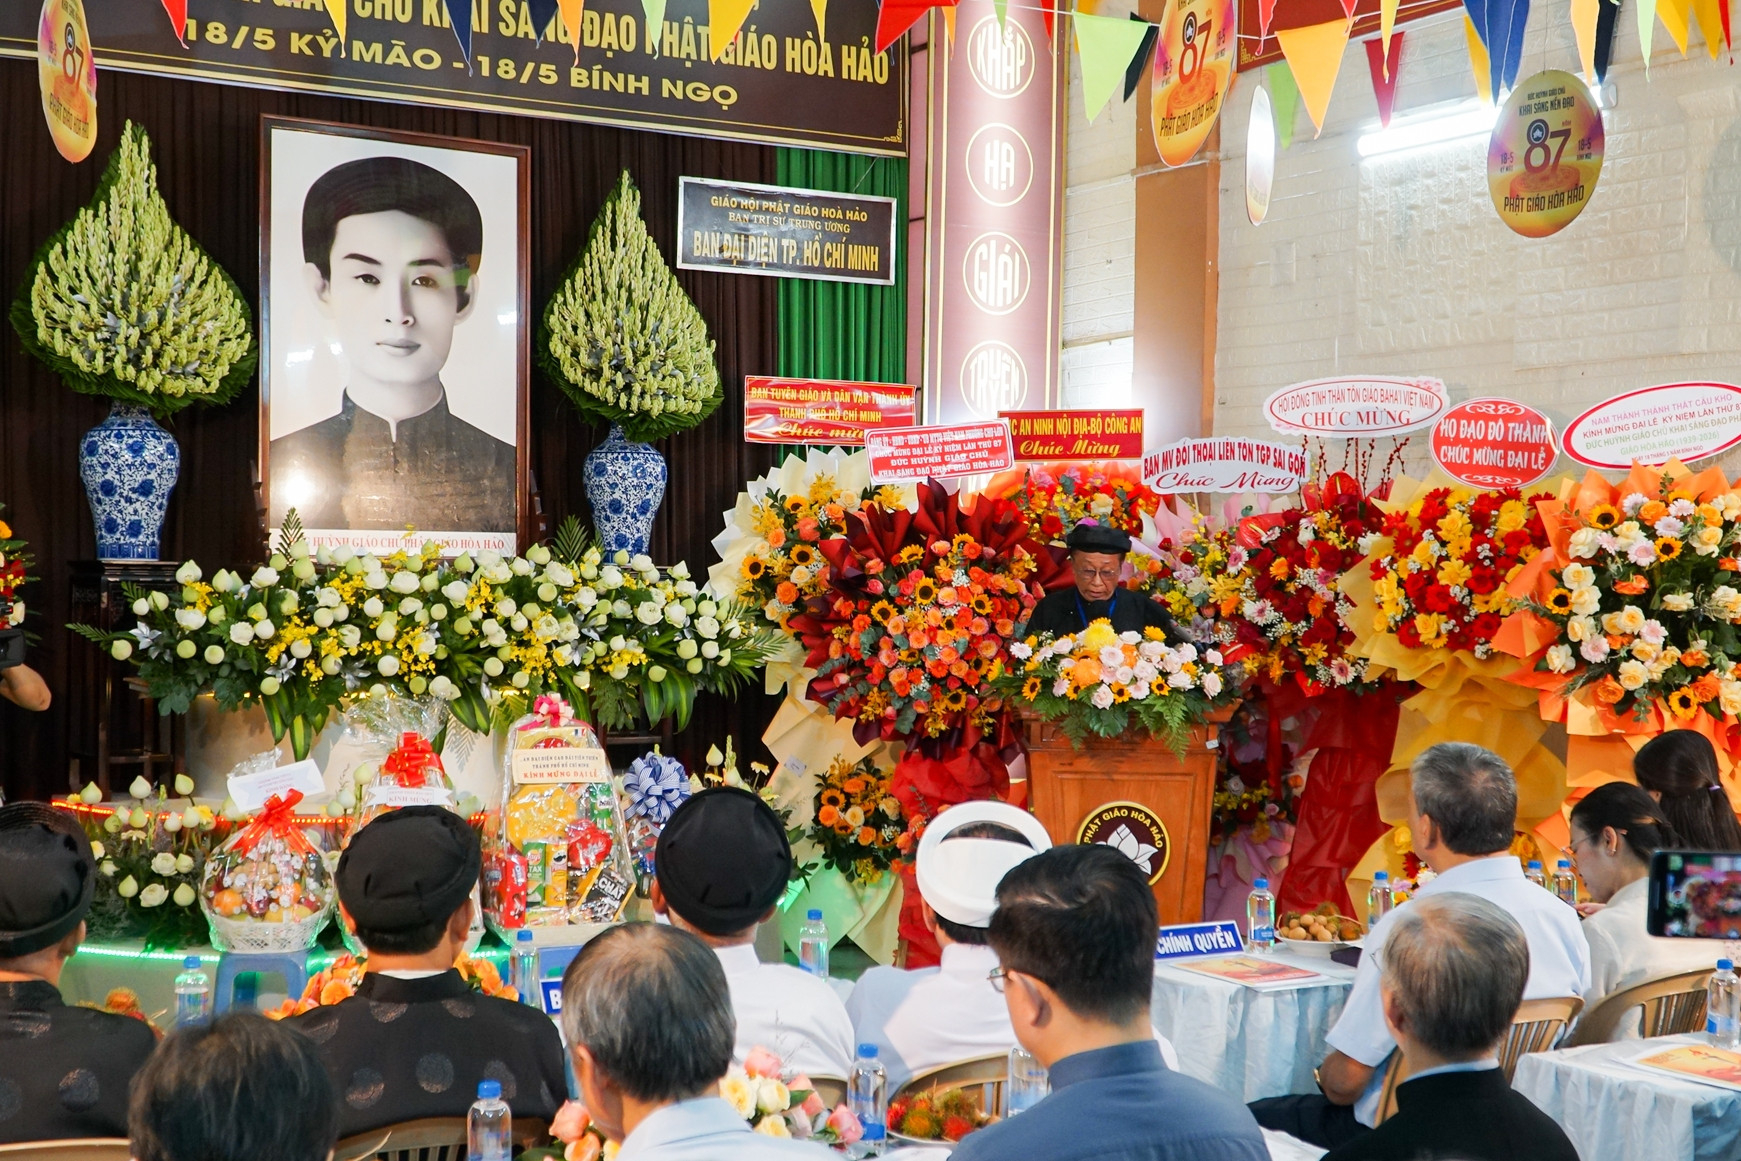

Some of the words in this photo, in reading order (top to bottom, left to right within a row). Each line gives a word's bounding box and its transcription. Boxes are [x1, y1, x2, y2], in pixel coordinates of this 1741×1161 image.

[582, 9, 637, 58] ĐẠO
[785, 30, 834, 78] HÒA
[841, 35, 889, 85] HẢO
[185, 18, 276, 51] 18/5
[290, 28, 339, 58] KỶ
[352, 39, 442, 70] MÃO
[477, 55, 558, 85] 18/5
[570, 64, 650, 96] BÍNH
[661, 78, 738, 111] NGỌ
[1519, 104, 1533, 116] KHAI
[1524, 118, 1572, 174] 87
[984, 139, 1016, 191] HẠ
[711, 193, 738, 209] GIÁO
[740, 197, 759, 212] HỘI
[762, 199, 791, 215] PHẬT
[793, 202, 819, 217] GIÁO
[821, 206, 844, 220] HOÀ
[846, 206, 868, 222] HẢO
[1504, 194, 1525, 216] PHẬT
[1526, 193, 1545, 213] GIÁO
[1547, 190, 1565, 210] HÒA
[1566, 183, 1585, 206] HẢO
[728, 211, 750, 224] BAN
[752, 214, 770, 227] TRỊ
[788, 217, 822, 231] TRUNG
[824, 220, 851, 234] ƯƠNG
[693, 230, 720, 258] BAN
[722, 232, 745, 266] ĐẠI
[748, 230, 778, 269] DIỆN
[781, 238, 800, 266] TP.
[803, 232, 822, 267] HỒ
[823, 236, 847, 269] CHÍ
[847, 244, 879, 272] MINH
[751, 387, 768, 400] BAN
[770, 386, 797, 401] TUYÊN
[799, 387, 819, 402] GIÁO
[821, 388, 832, 402] VÀ
[834, 389, 851, 404] DÂN
[853, 390, 869, 406] VẬN
[1311, 389, 1327, 407] TINH
[1347, 384, 1361, 403] TÔN
[1362, 385, 1379, 403] GIÁO
[1403, 390, 1418, 410] VIỆT
[1419, 393, 1435, 410] NAM
[843, 408, 858, 422] CHÍ
[860, 410, 882, 423] MINH
[1019, 418, 1032, 436] AN
[1034, 418, 1054, 436] NINH
[1056, 413, 1072, 439] NỘI
[1073, 412, 1102, 439] ĐỊA-BỘ
[1104, 412, 1128, 435] CÔNG
[1129, 416, 1142, 434] AN
[1301, 407, 1351, 427] CHÚC
[1356, 406, 1411, 426] MỪNG
[1591, 415, 1610, 427] NAM
[779, 421, 824, 437] Chúc
[1440, 418, 1457, 442] HỌ
[1460, 419, 1486, 443] ĐẠO
[1487, 418, 1505, 442] ĐÔ
[1507, 420, 1550, 445] THÀNH
[993, 438, 1003, 448] 87
[1020, 440, 1064, 456] Chúc
[1066, 439, 1121, 457] Mừng
[890, 456, 909, 467] ĐỨC
[910, 454, 942, 465] HUỲNH
[969, 449, 989, 460] CHỦ
[1144, 453, 1160, 480] BAN
[1161, 448, 1174, 472] MV
[1192, 441, 1216, 466] THOẠI
[1218, 437, 1235, 461] LIÊN
[1238, 438, 1254, 463] TÔN
[1255, 444, 1271, 466] TGP
[1440, 444, 1470, 465] CHÚC
[1472, 446, 1505, 468] MỪNG
[1507, 450, 1529, 472] ĐẠI
[1531, 446, 1546, 471] LỄ
[1155, 472, 1216, 490] Chúc
[1219, 471, 1295, 492] Mừng
[352, 534, 378, 547] GIÁO
[460, 536, 481, 549] HÒA
[483, 536, 505, 550] HẢO
[1083, 818, 1102, 844] PHẬT
[1102, 808, 1129, 821] GIÁO
[1130, 810, 1152, 827] HÒA
[1149, 825, 1164, 848] HẢO
[1156, 931, 1194, 955] CHÍNH
[1193, 925, 1237, 954] QUYỀN
